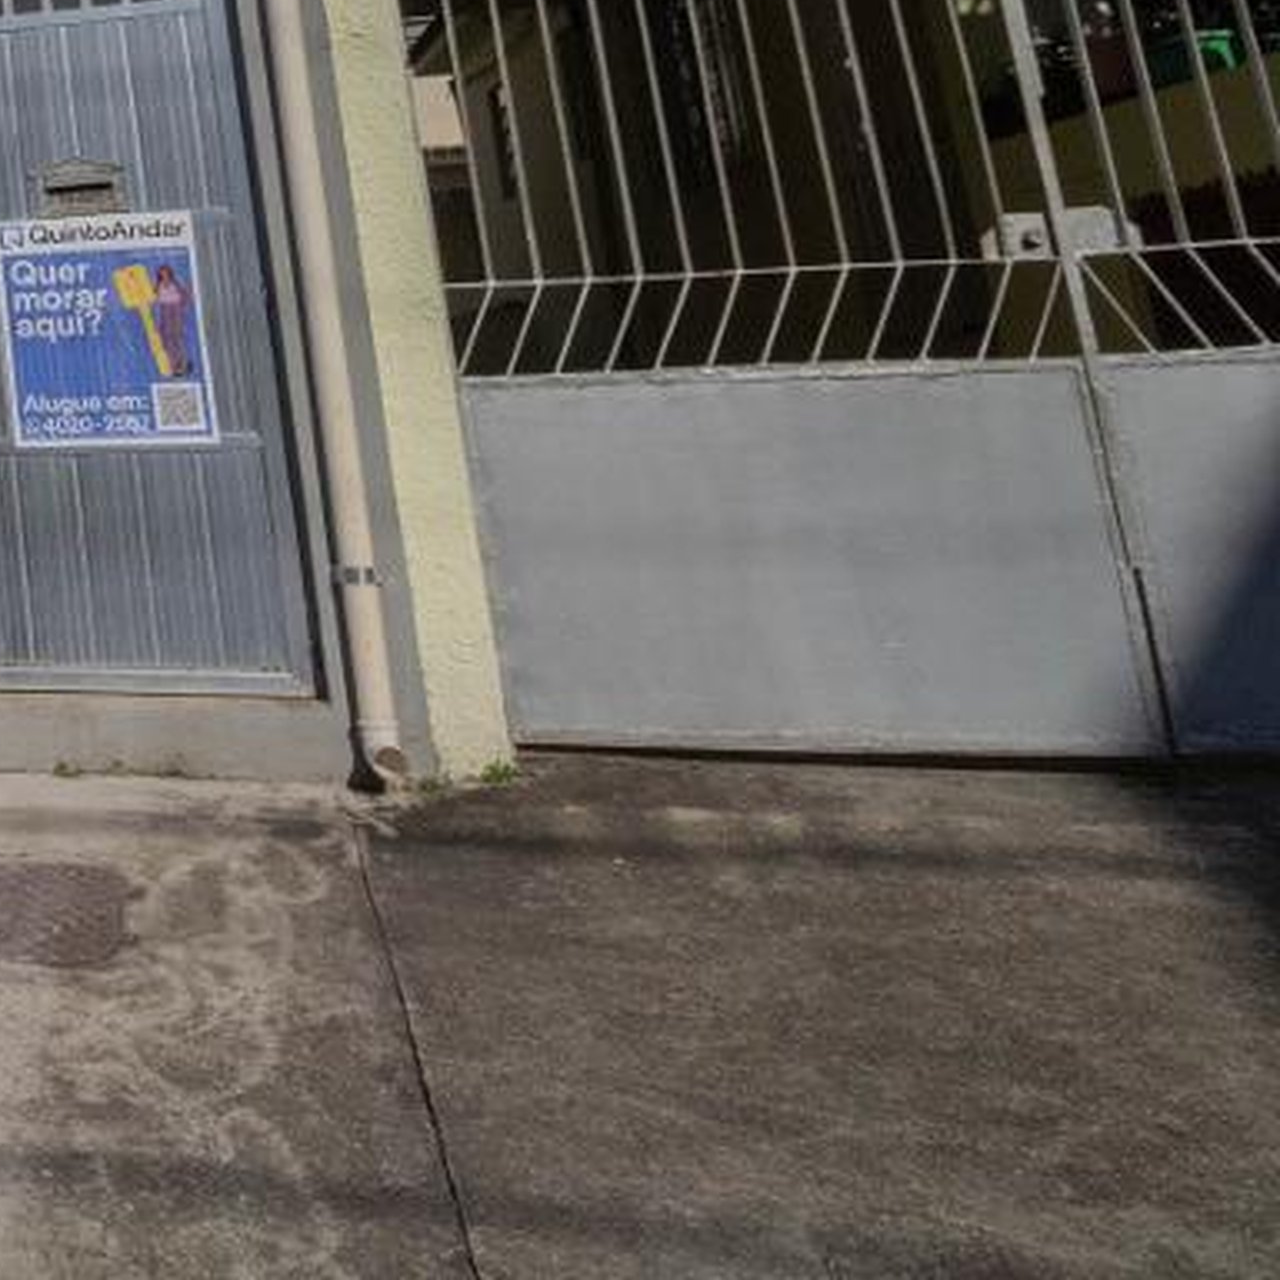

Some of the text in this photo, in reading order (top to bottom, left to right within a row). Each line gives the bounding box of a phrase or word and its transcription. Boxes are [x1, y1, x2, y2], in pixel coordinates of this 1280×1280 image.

[28, 220, 186, 245] QuintoAndar
[10, 260, 91, 286] Quer
[14, 287, 109, 312] morar
[15, 310, 104, 343] aqui?
[23, 394, 150, 418] Alugue em:
